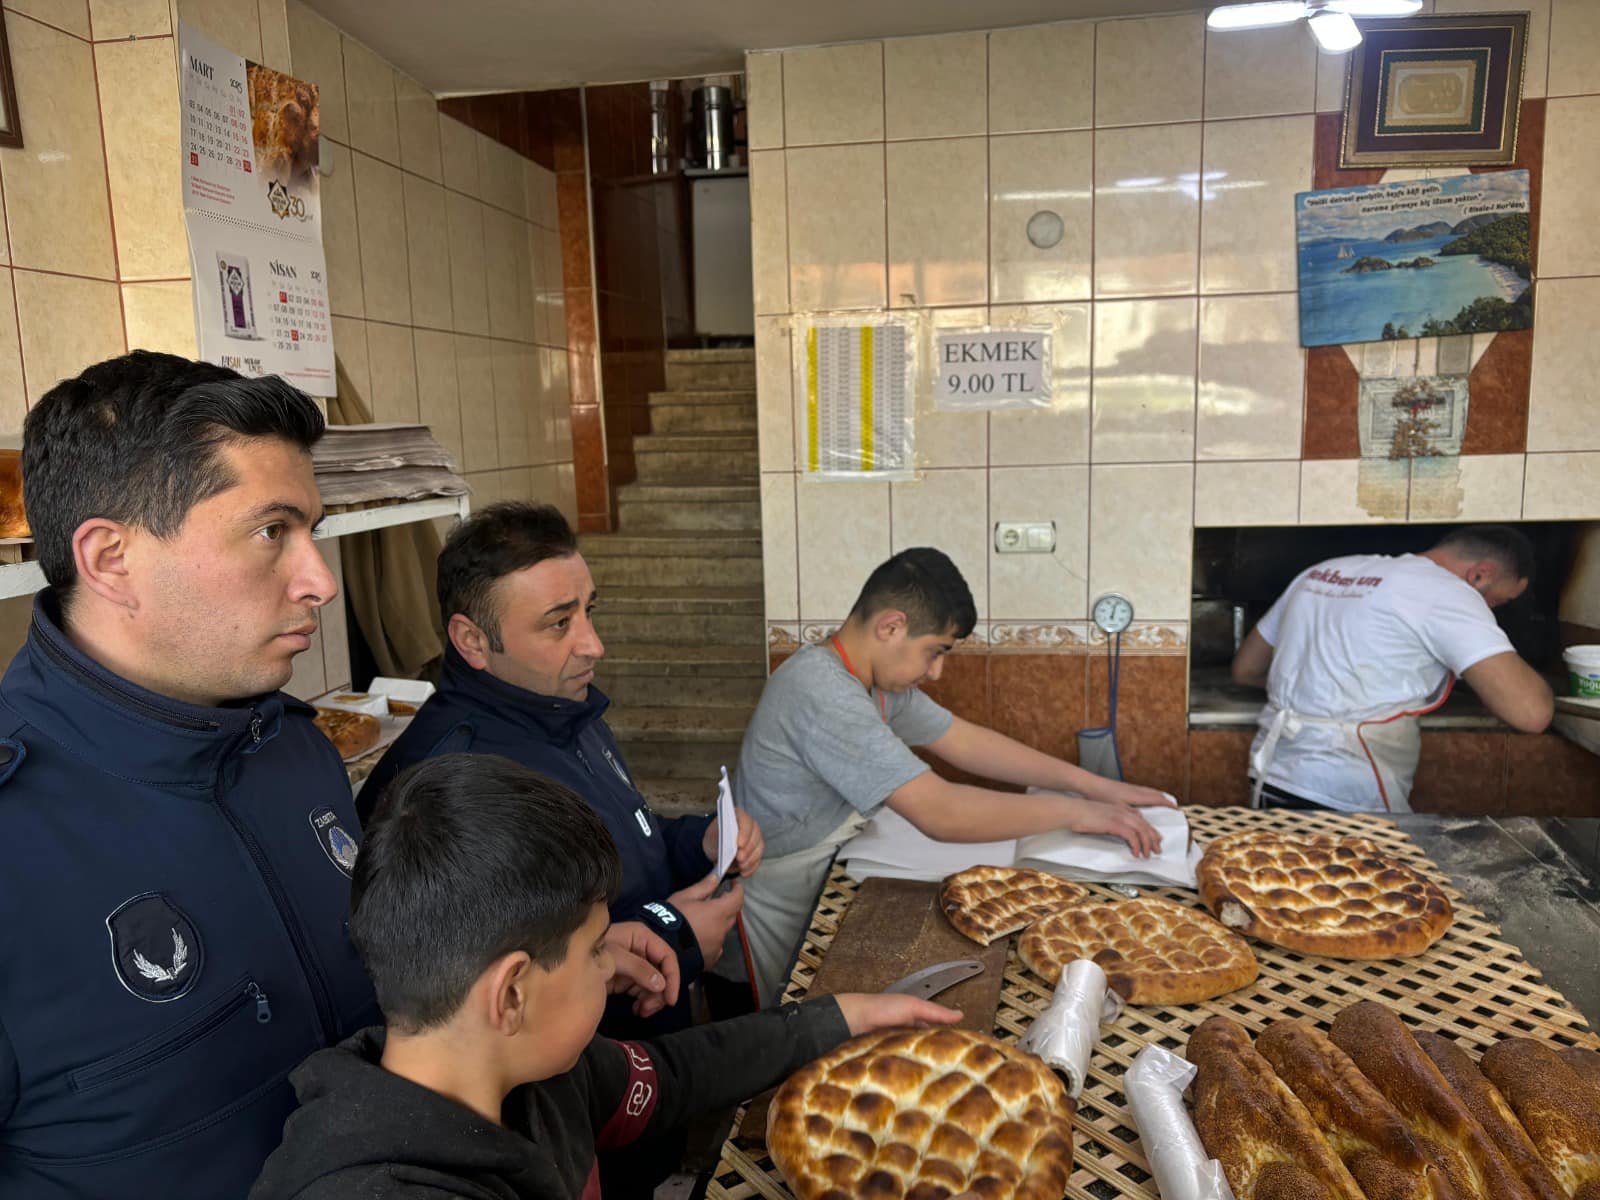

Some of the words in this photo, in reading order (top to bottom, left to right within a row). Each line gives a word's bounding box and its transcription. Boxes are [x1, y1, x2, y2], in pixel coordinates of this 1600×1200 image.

[189, 55, 215, 81] MART
[268, 258, 297, 279] NİSAN
[944, 340, 1038, 363] EKMEK
[948, 373, 994, 394] 9.00
[1001, 372, 1034, 393] TL
